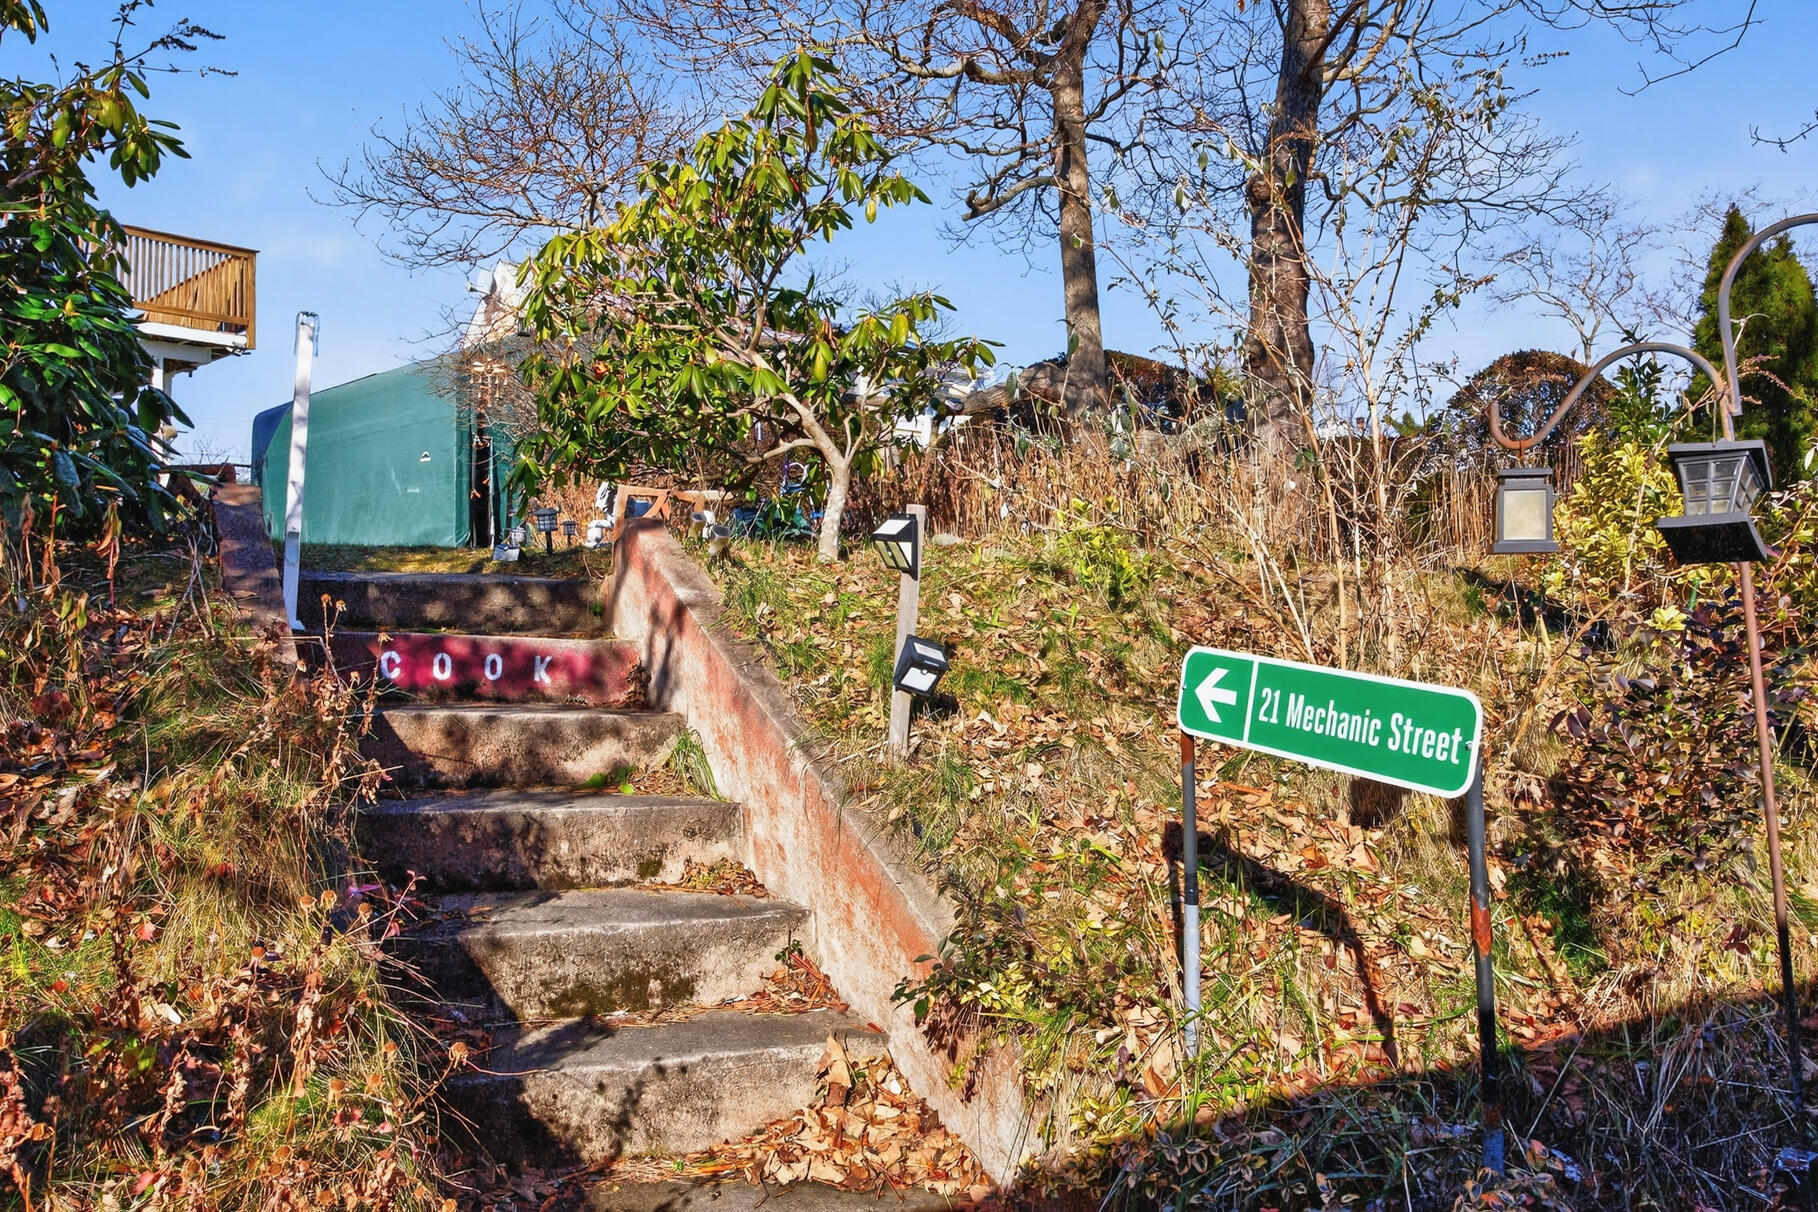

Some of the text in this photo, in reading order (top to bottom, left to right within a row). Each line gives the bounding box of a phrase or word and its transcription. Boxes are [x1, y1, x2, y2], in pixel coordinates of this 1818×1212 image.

[380, 650, 552, 684] COOK
[1258, 687, 1463, 765] 21 Mechanic Street
